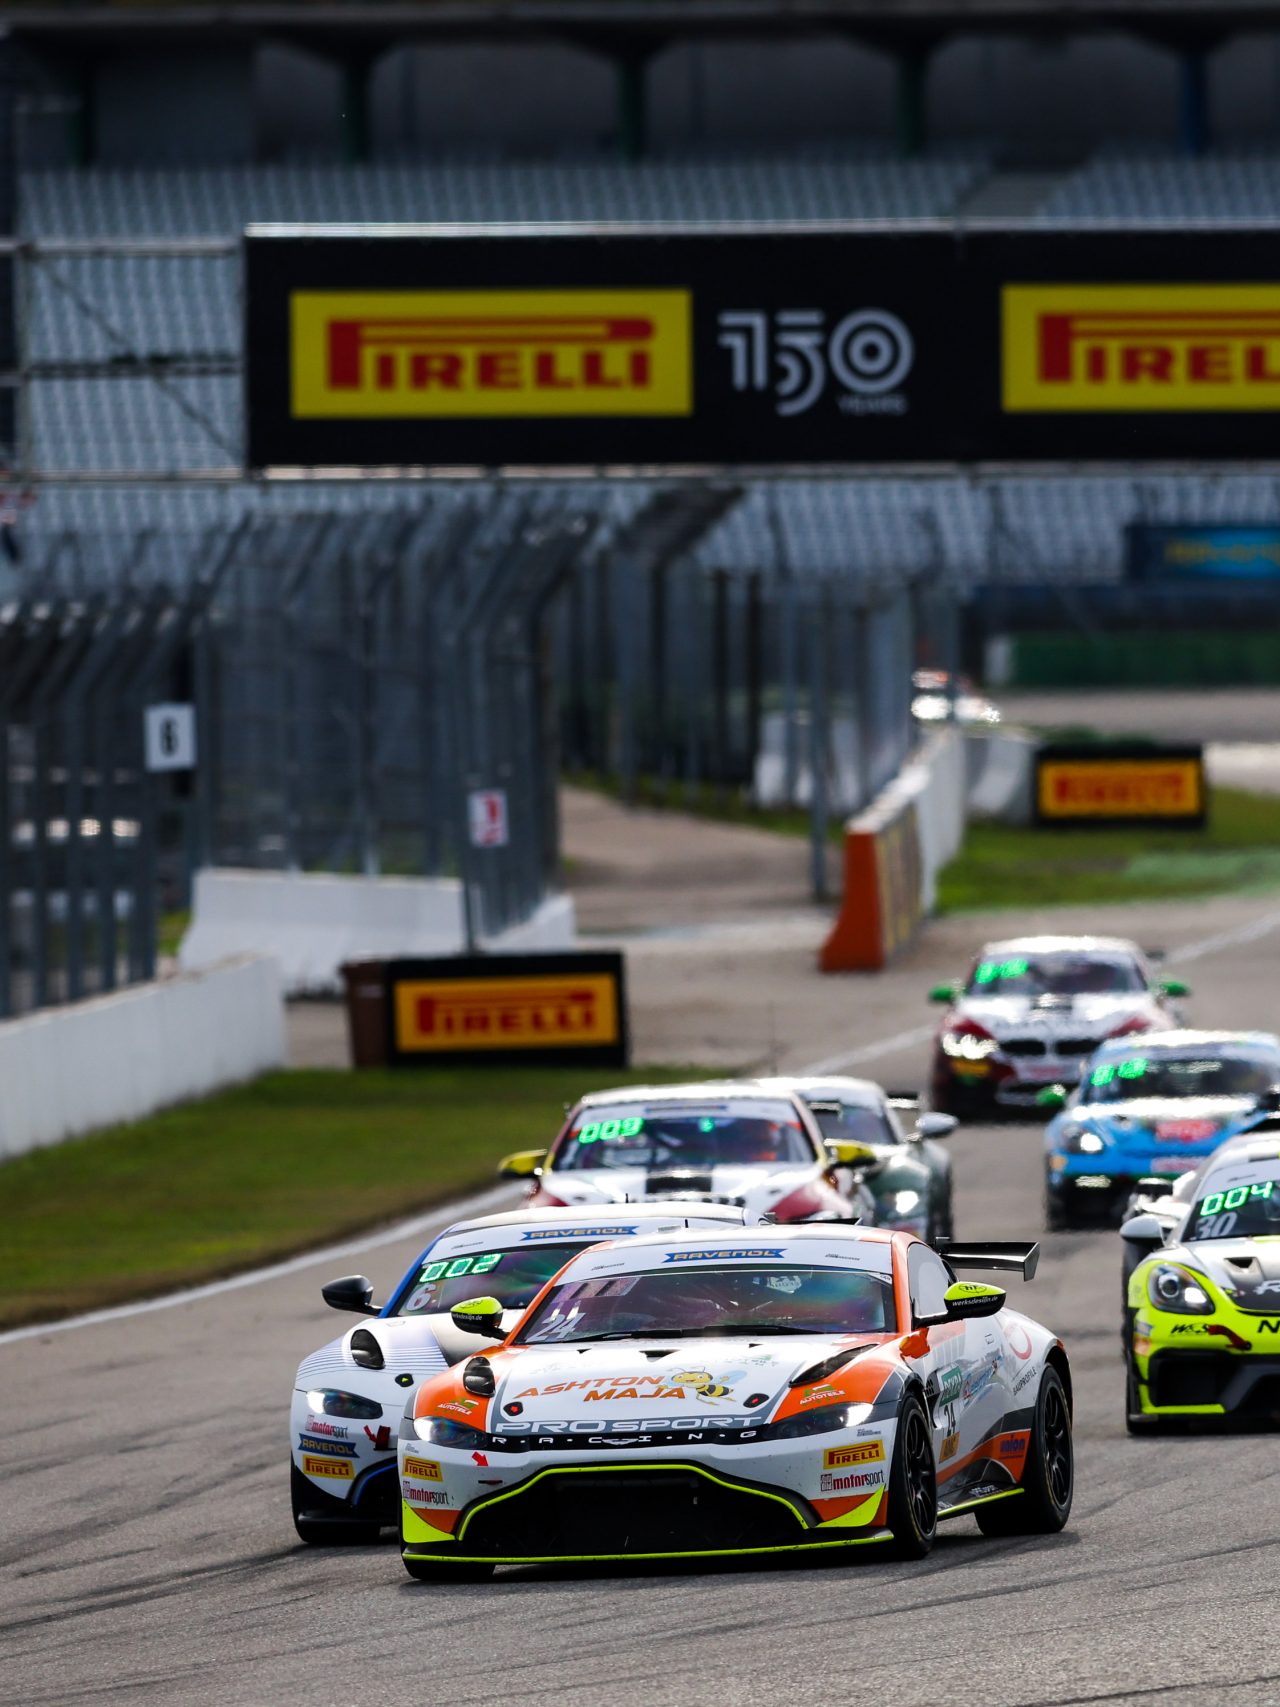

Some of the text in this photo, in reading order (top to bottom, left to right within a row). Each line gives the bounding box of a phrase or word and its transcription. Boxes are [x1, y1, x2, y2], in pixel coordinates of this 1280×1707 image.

[325, 317, 656, 391] PIRELLI
[717, 308, 915, 416] 150
[158, 719, 180, 757] 6
[416, 989, 595, 1035] PIRELLI
[1200, 1181, 1274, 1216] 004
[529, 1226, 628, 1240] RAVENOL
[1196, 1212, 1238, 1239] 30
[674, 1249, 776, 1262] RAVENOL
[419, 1253, 502, 1283] 002
[406, 1284, 436, 1311] 6
[525, 1312, 586, 1343] 24
[512, 1375, 665, 1398] ASHTON
[584, 1387, 687, 1402] MAJA
[311, 1421, 349, 1439] motorsport
[302, 1439, 351, 1455] RAVENOL
[828, 1443, 879, 1465] PIRELLI
[305, 1455, 350, 1476] PIRELLI
[405, 1458, 438, 1479] PIRELLI
[833, 1469, 884, 1490] motorsport
[410, 1488, 450, 1505] motorsport
